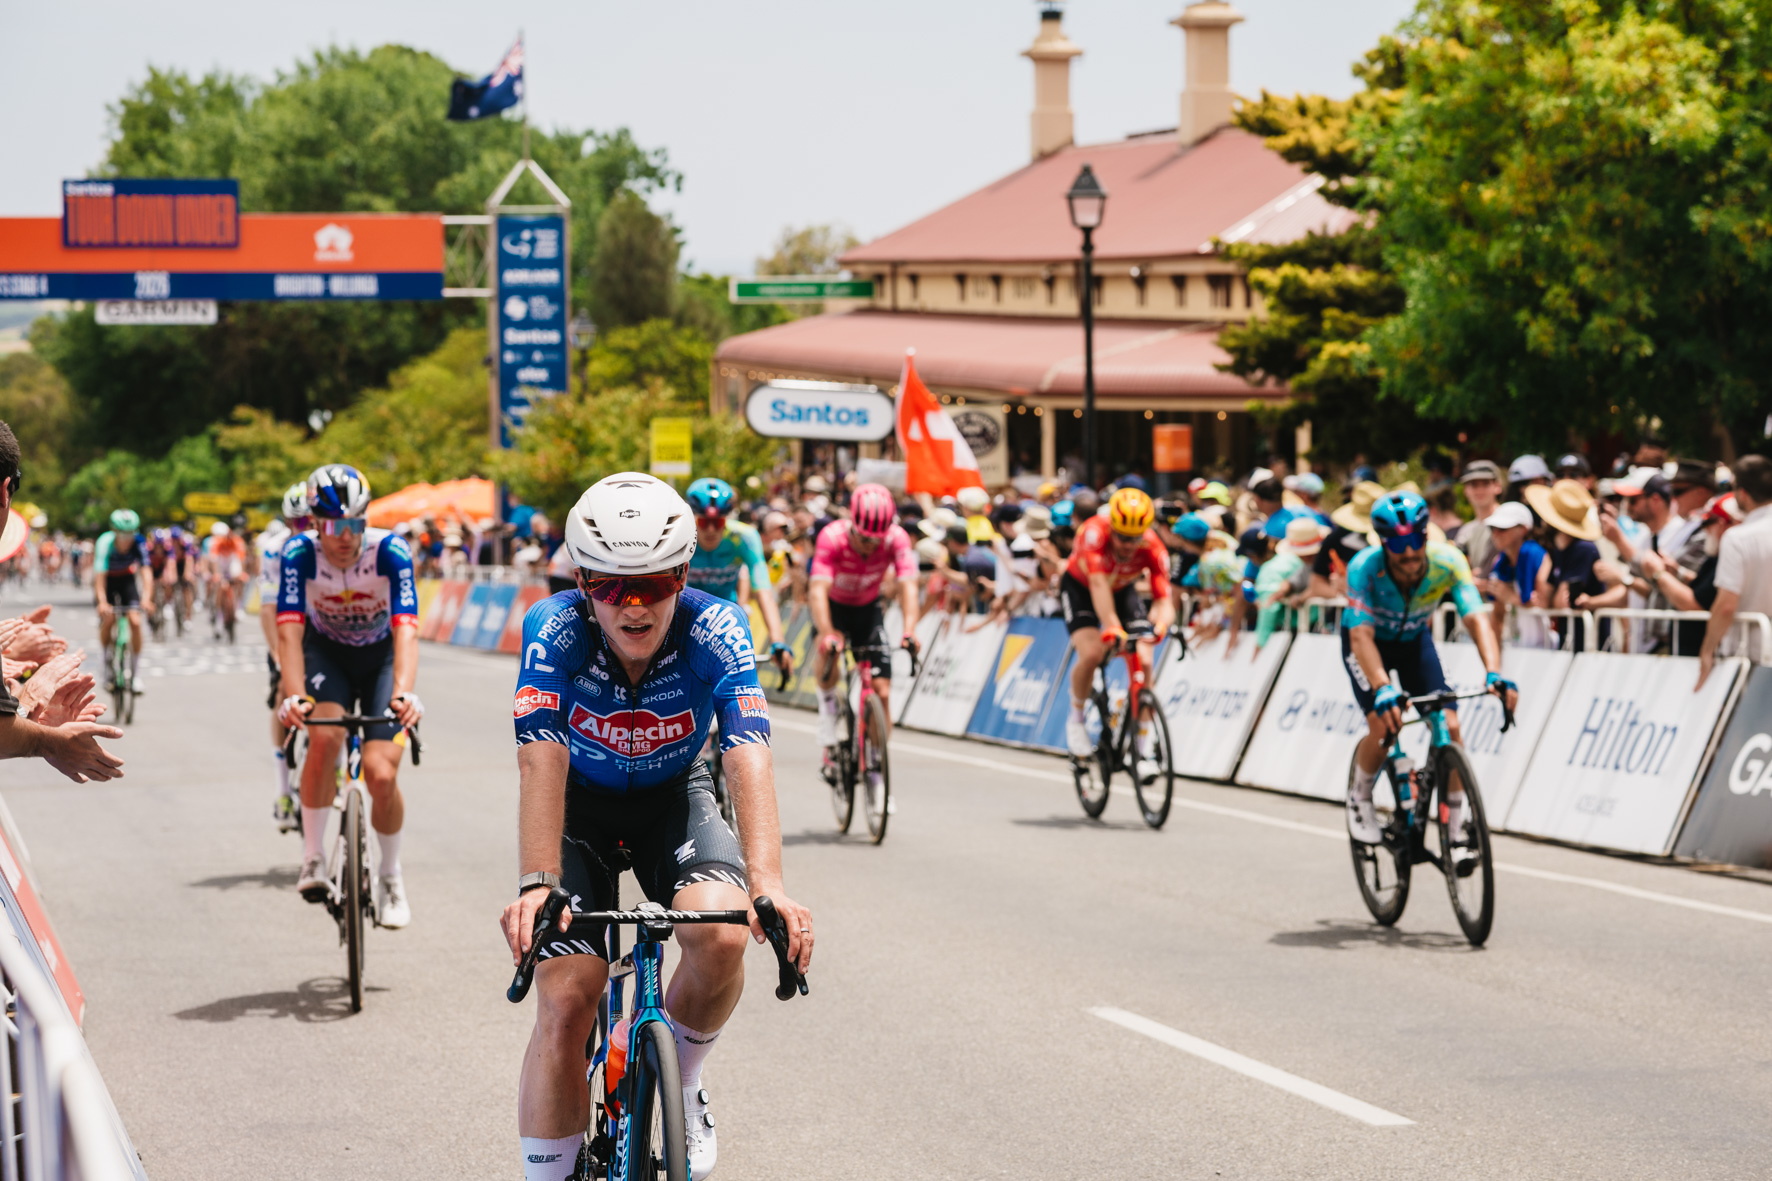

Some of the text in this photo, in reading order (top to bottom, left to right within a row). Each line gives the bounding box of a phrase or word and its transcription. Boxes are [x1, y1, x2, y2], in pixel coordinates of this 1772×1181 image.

[66, 183, 114, 197] Santos
[104, 300, 209, 317] GARMIN
[503, 327, 561, 345] Santos
[770, 399, 870, 426] Santos
[612, 541, 650, 549] CANYON
[285, 566, 299, 604] BOSS
[399, 567, 415, 607] BOSS
[537, 606, 580, 642] PREMIER
[695, 603, 755, 672] Alpecin
[577, 678, 599, 694] ABUS
[643, 671, 681, 690] CANYON
[578, 716, 684, 745] Alpecin
[1567, 697, 1680, 776] Hilton
[614, 745, 691, 767] PREMIER
[617, 741, 652, 753] DMG
[617, 761, 662, 774] TECH
[606, 910, 701, 920] CANYON
[527, 1154, 545, 1162] AERO
